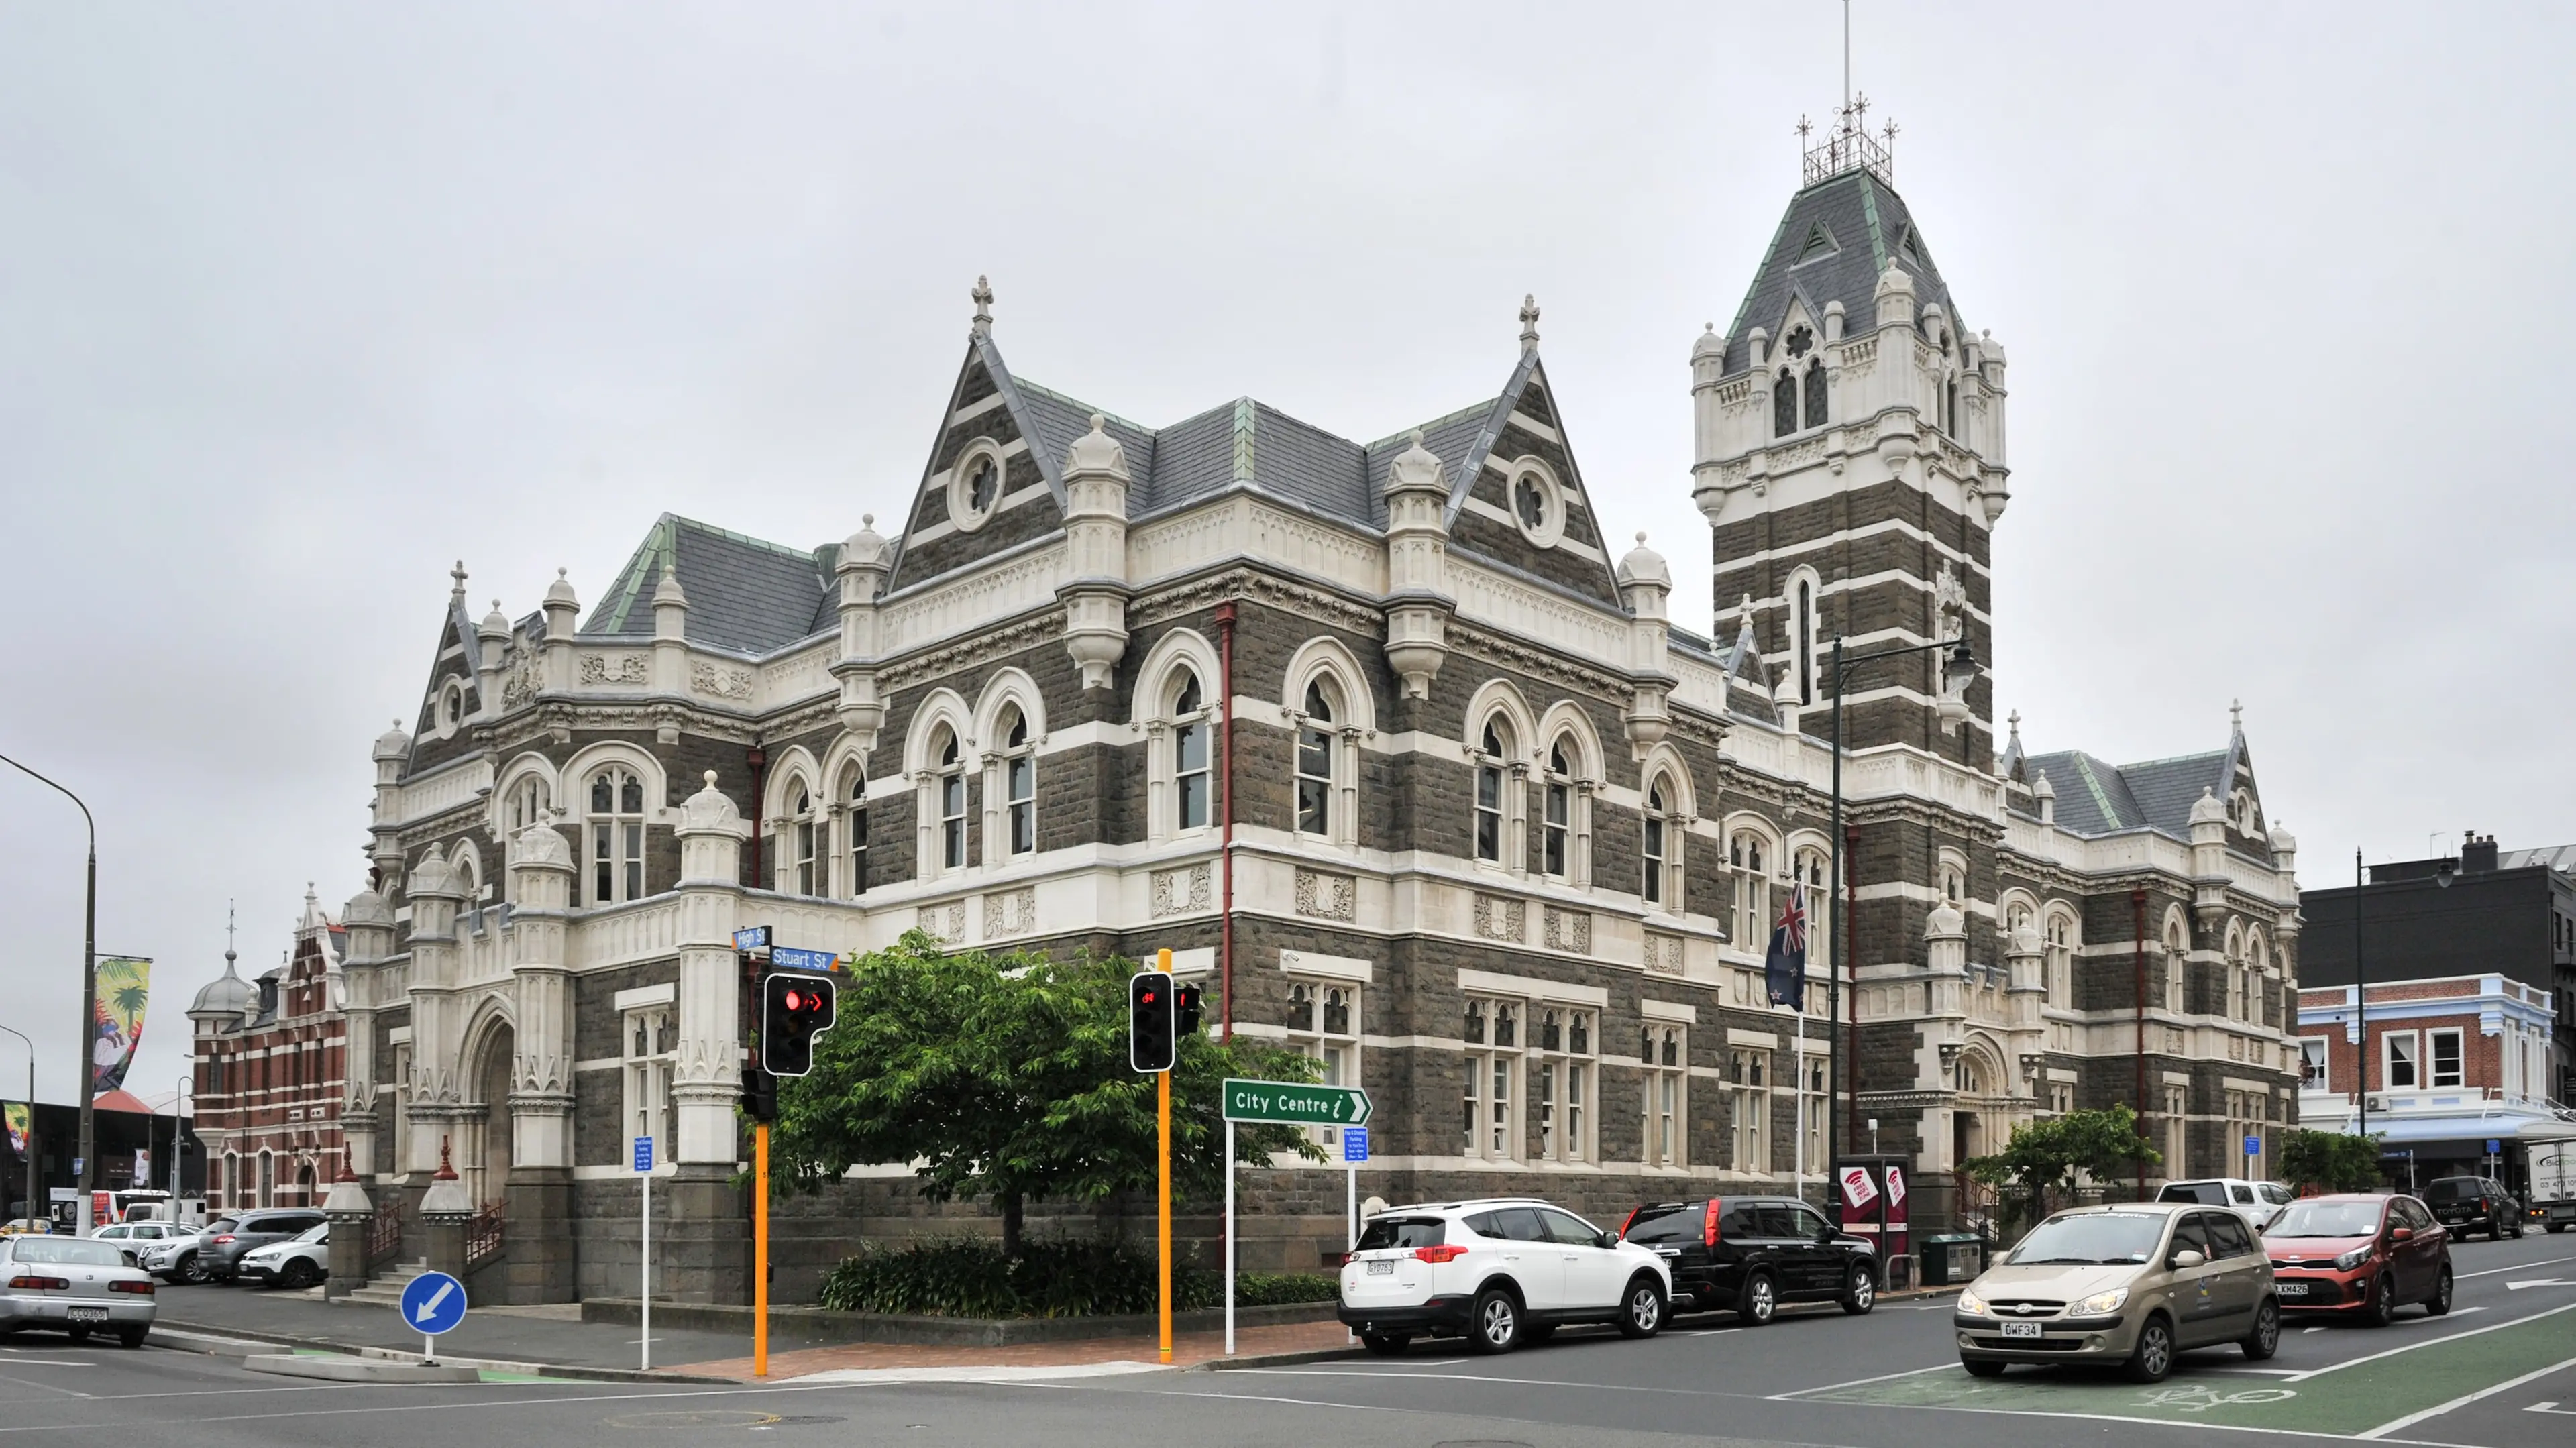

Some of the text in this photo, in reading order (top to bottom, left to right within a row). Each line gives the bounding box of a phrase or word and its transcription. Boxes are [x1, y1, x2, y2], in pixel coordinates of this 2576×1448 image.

[738, 928, 765, 947] High St
[773, 948, 828, 968] Stuart St
[1236, 1092, 1269, 1113] City
[1278, 1095, 1328, 1113] Centre
[2437, 1206, 2472, 1215] TOYOTA
[1369, 1263, 1393, 1273] GYD763
[2276, 1285, 2308, 1294] LKM426
[2005, 1325, 2037, 1336] DWF34
